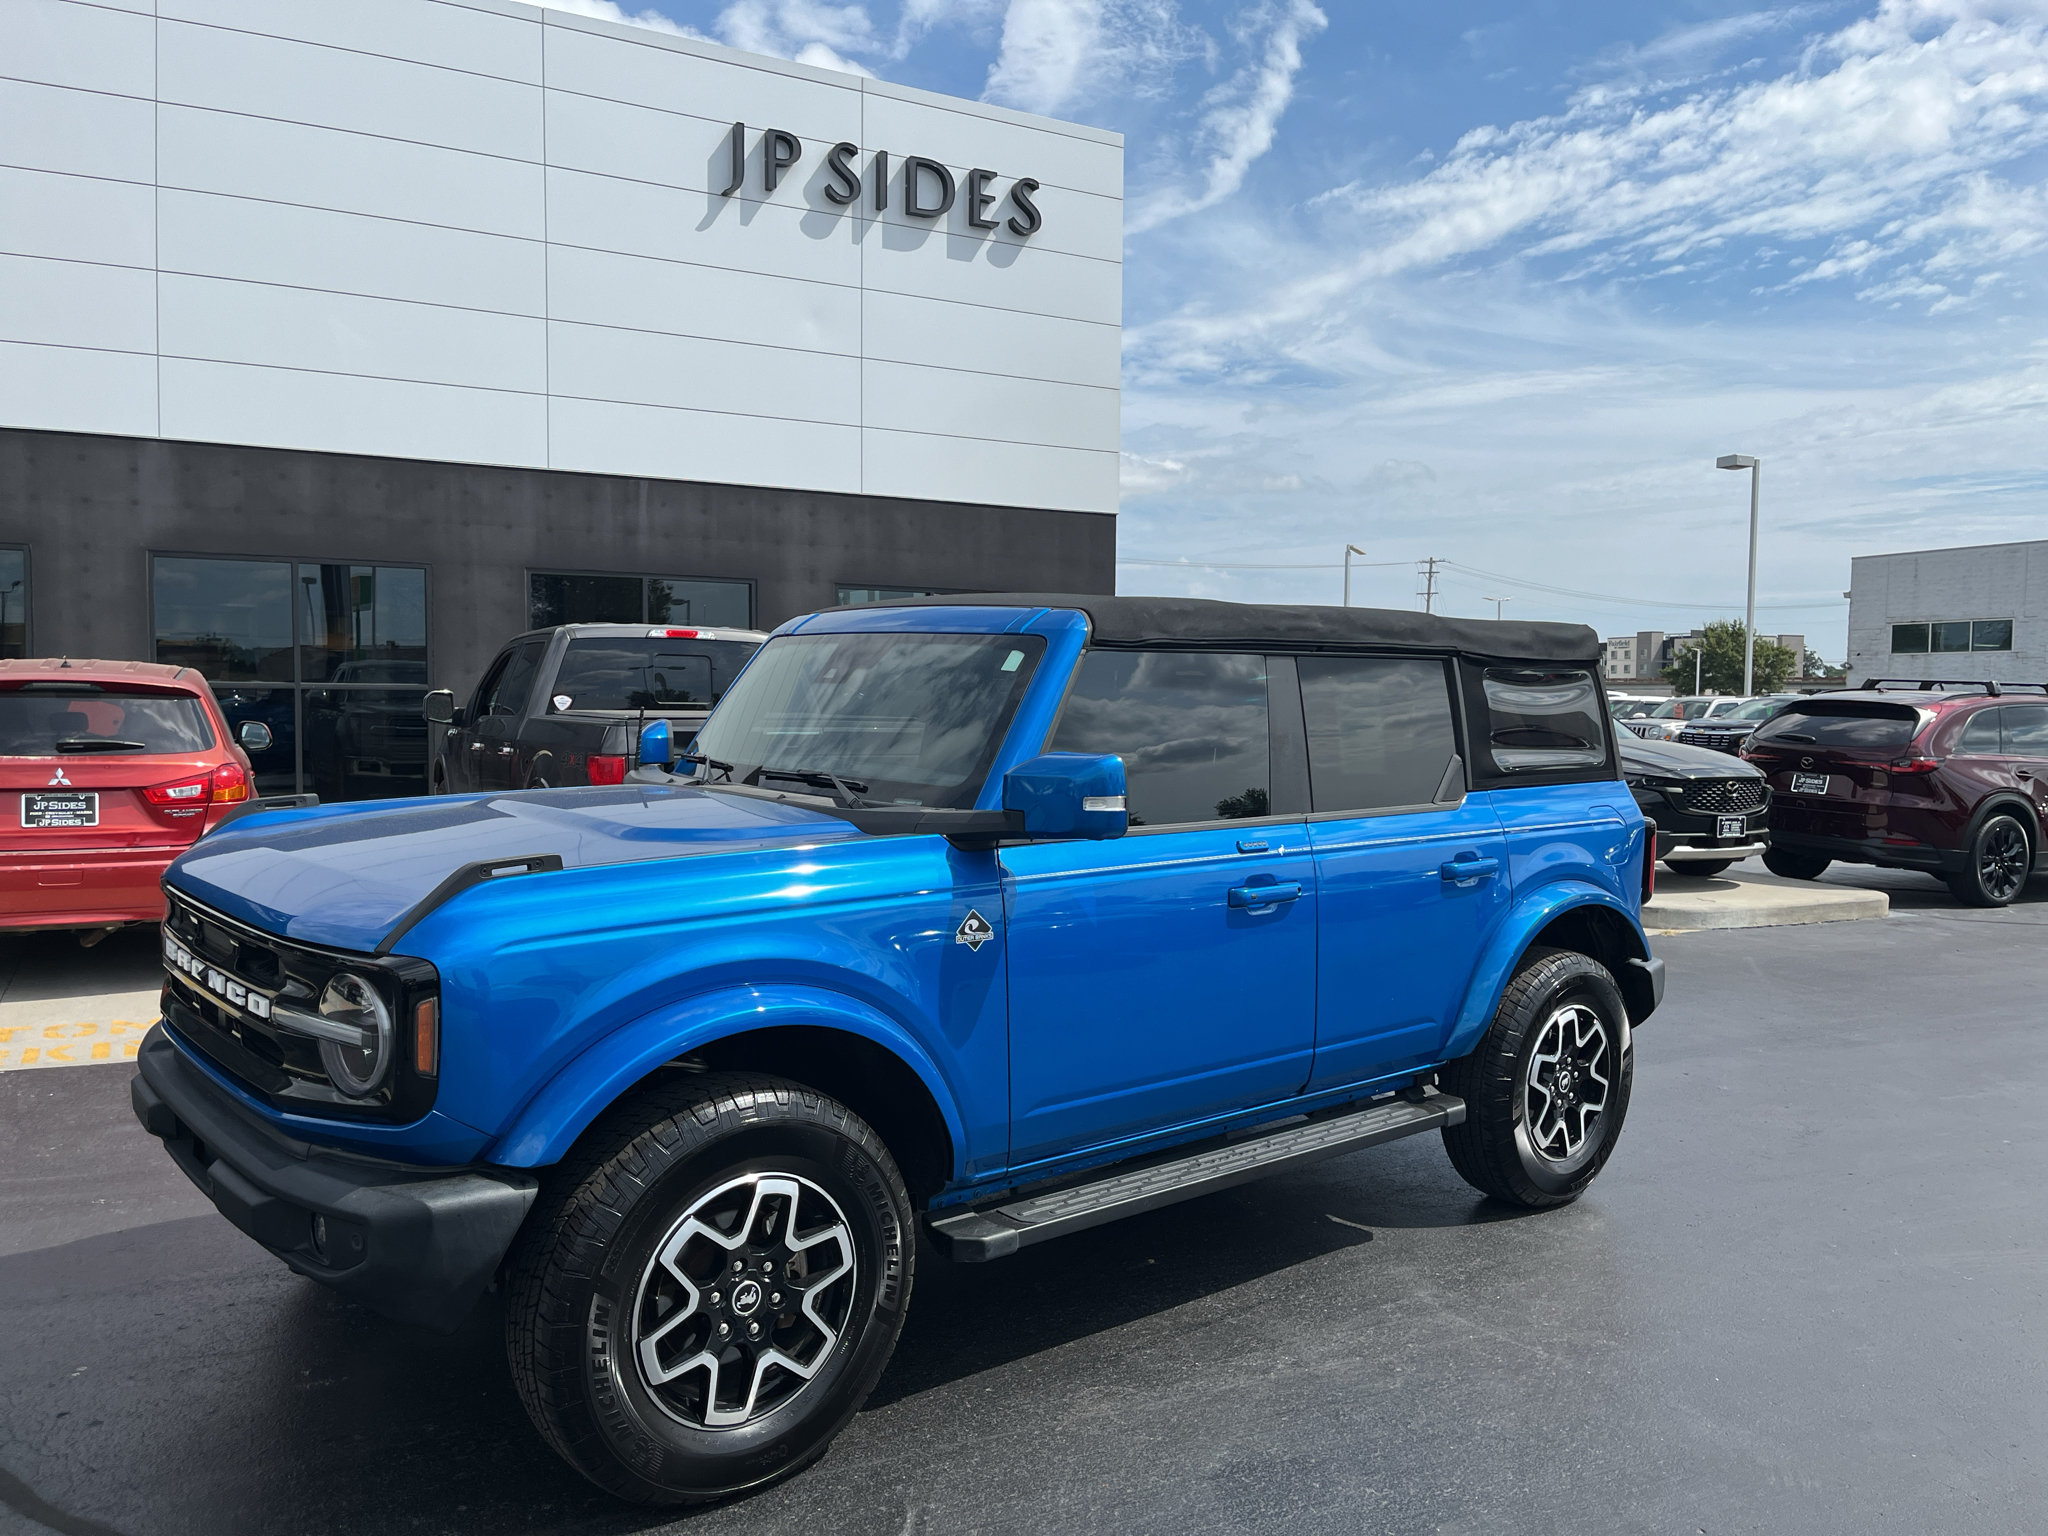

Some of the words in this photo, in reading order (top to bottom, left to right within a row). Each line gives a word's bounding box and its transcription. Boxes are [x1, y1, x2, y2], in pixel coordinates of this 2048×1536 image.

[721, 121, 802, 196] JP
[824, 142, 1042, 236] SIDES
[33, 801, 48, 810] JP
[48, 801, 86, 810] SIDES
[51, 818, 82, 826] SIDES
[866, 1181, 899, 1303] MICHELIN
[592, 1303, 634, 1442] MICHELIN
